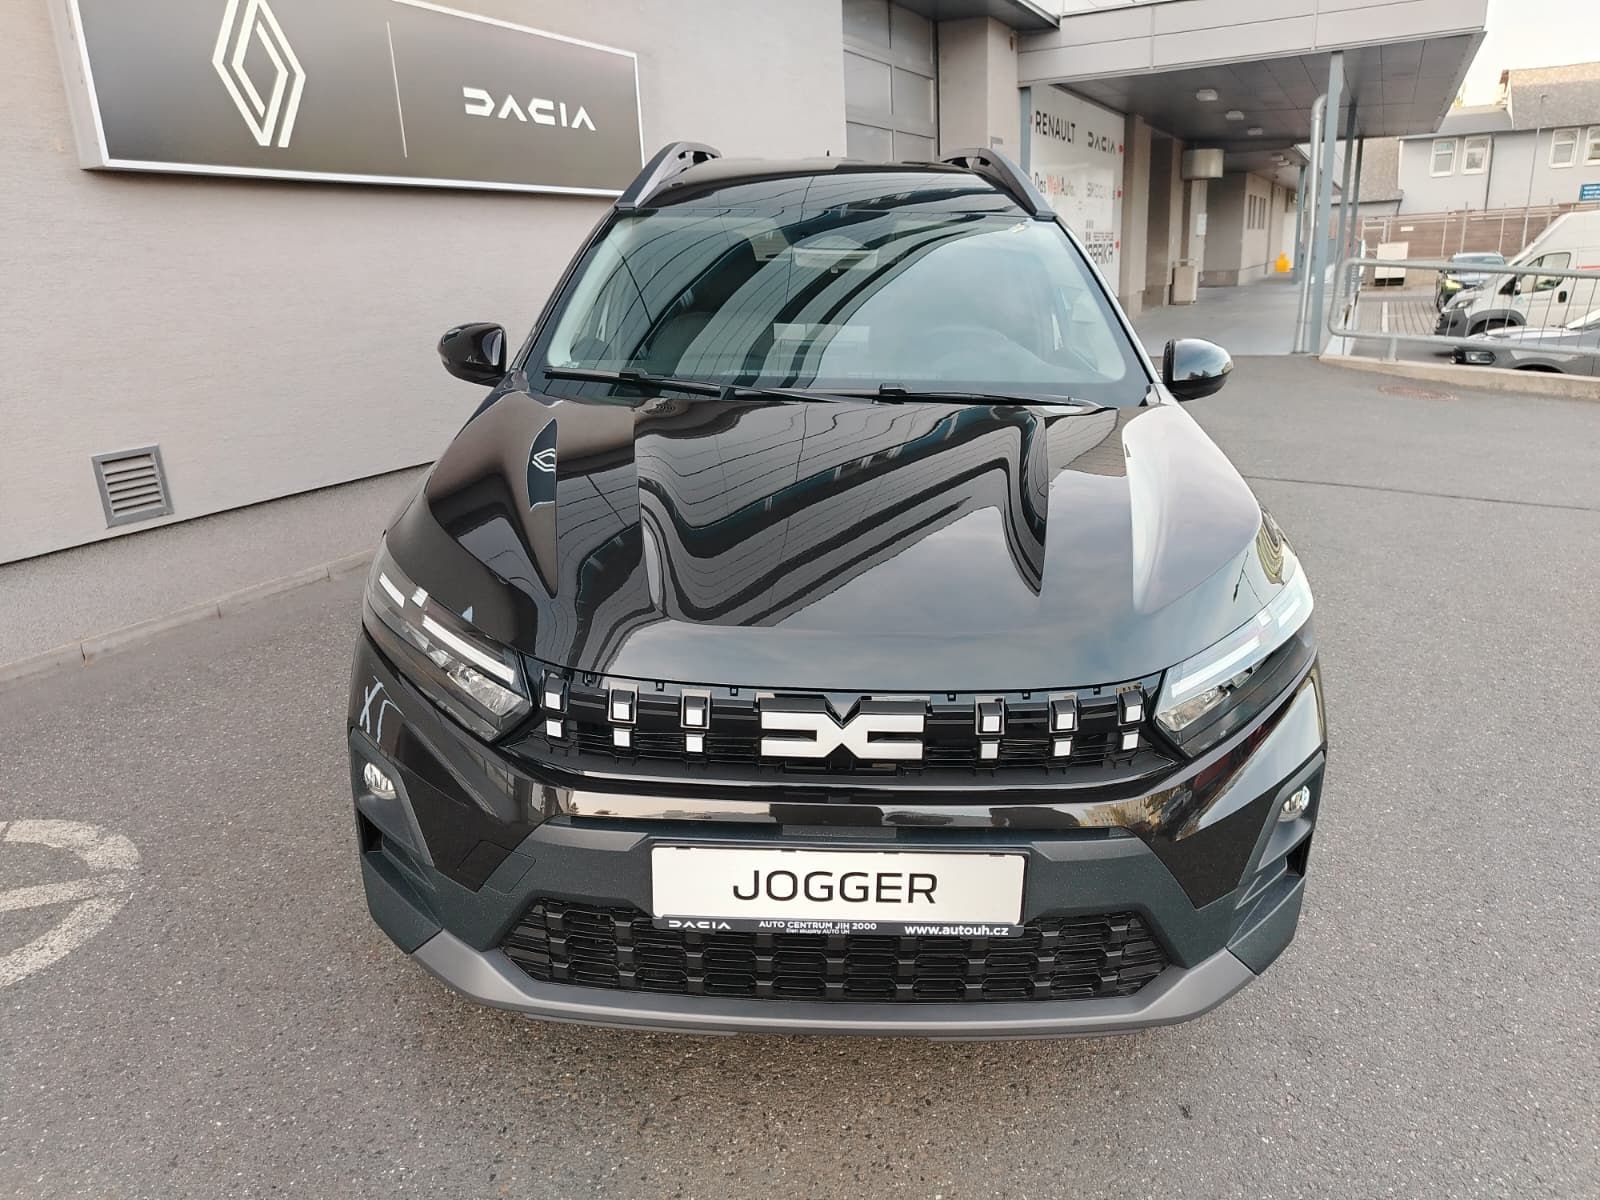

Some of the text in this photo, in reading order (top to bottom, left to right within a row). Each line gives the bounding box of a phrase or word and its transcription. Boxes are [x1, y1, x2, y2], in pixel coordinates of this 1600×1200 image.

[462, 86, 597, 131] DACIA
[1035, 110, 1076, 144] RENAULT
[1088, 131, 1116, 154] DACIA
[733, 870, 938, 904] JOGGER
[668, 920, 732, 930] DACIA
[758, 920, 877, 930] AUTO CENTRUM JIH 2000
[904, 925, 1009, 936] www.autouh.cz
